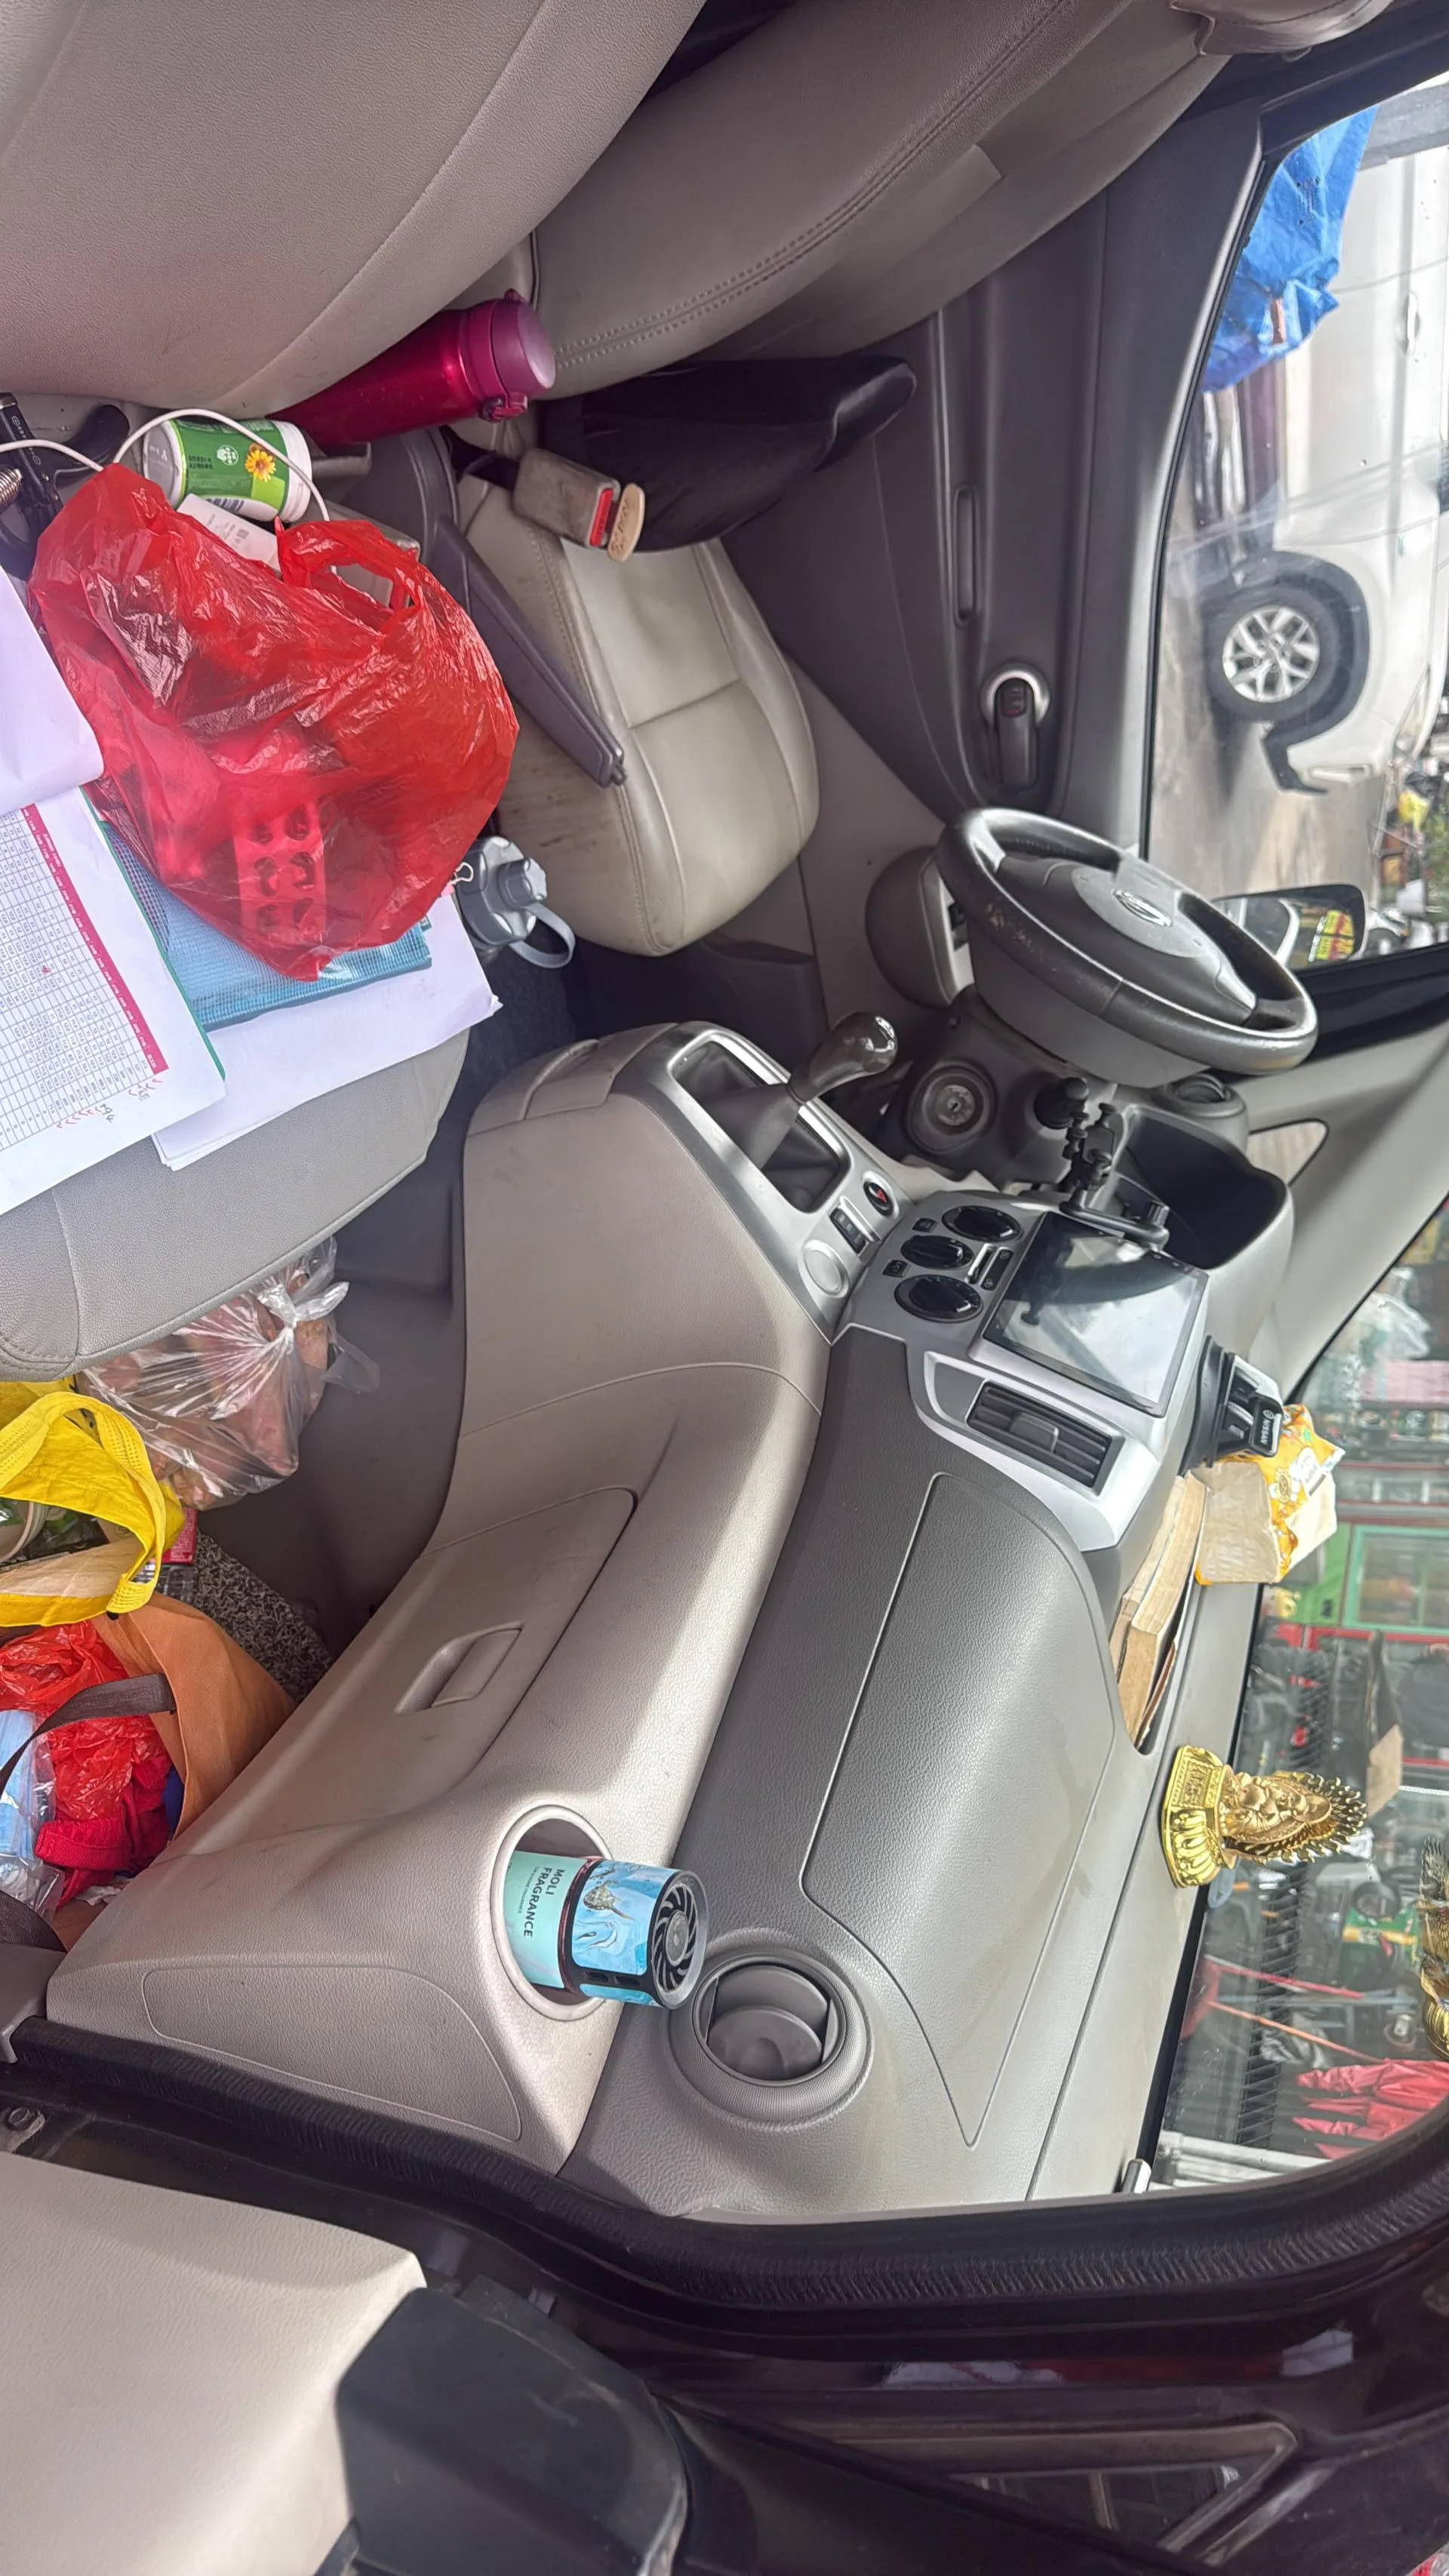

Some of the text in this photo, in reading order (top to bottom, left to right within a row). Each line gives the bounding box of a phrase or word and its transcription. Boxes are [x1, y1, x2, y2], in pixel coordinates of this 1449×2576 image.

[1259, 1417, 1270, 1445] NISSAN
[545, 1868, 565, 1895] MOLI
[522, 1867, 552, 1938] FRAGRANCE
